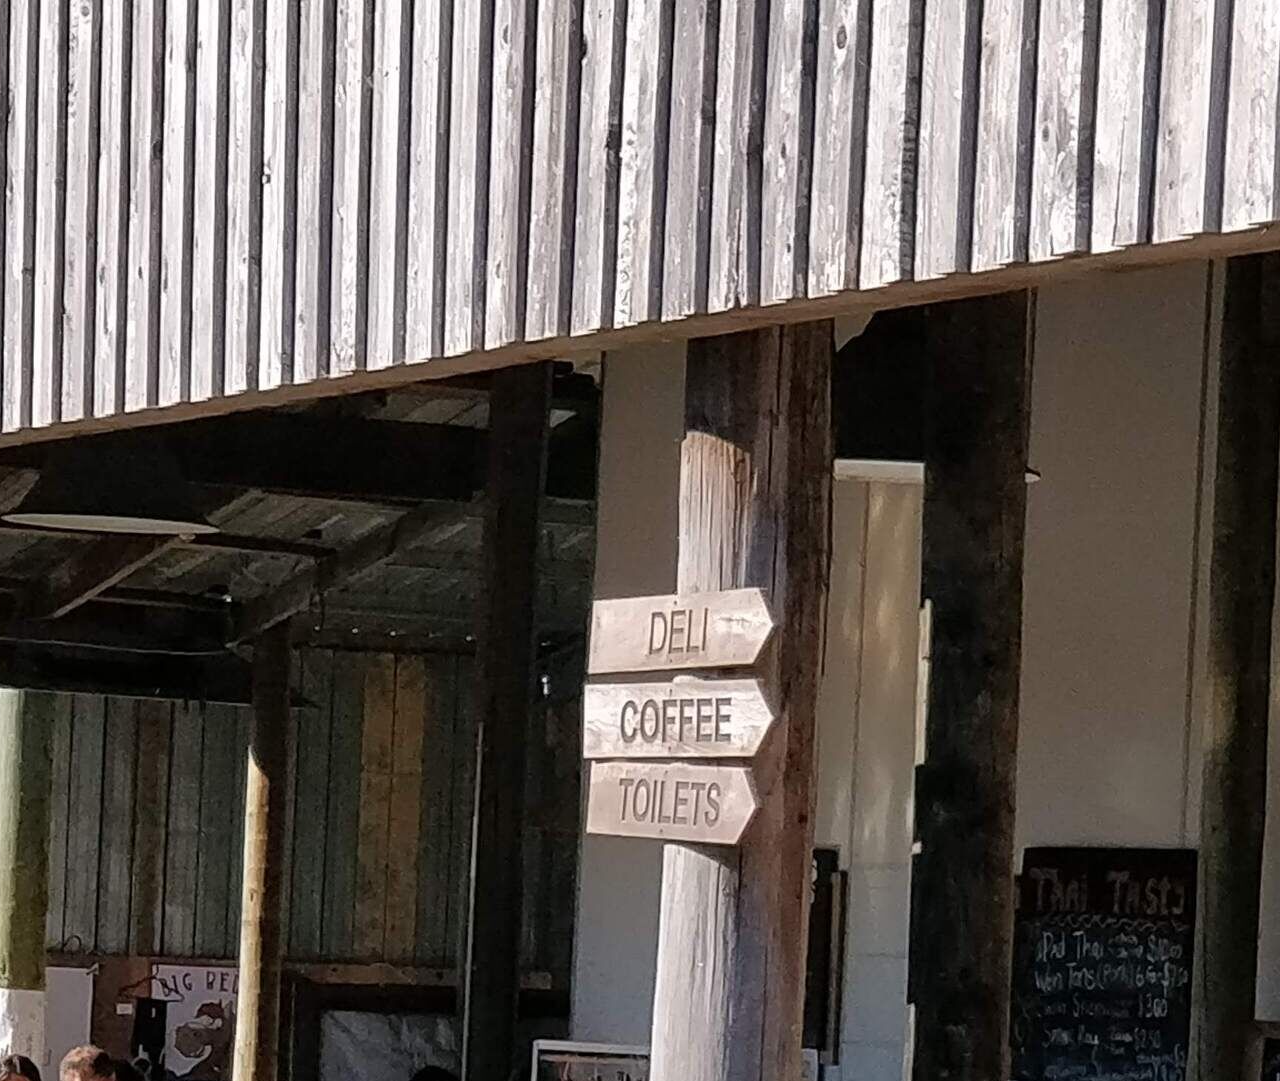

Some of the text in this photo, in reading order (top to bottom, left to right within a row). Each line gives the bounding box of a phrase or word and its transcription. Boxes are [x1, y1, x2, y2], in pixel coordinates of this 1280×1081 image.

[648, 607, 709, 655] DELI
[620, 697, 732, 744] COFFEE
[619, 778, 721, 828] TOILETS
[160, 973, 193, 997] BIG
